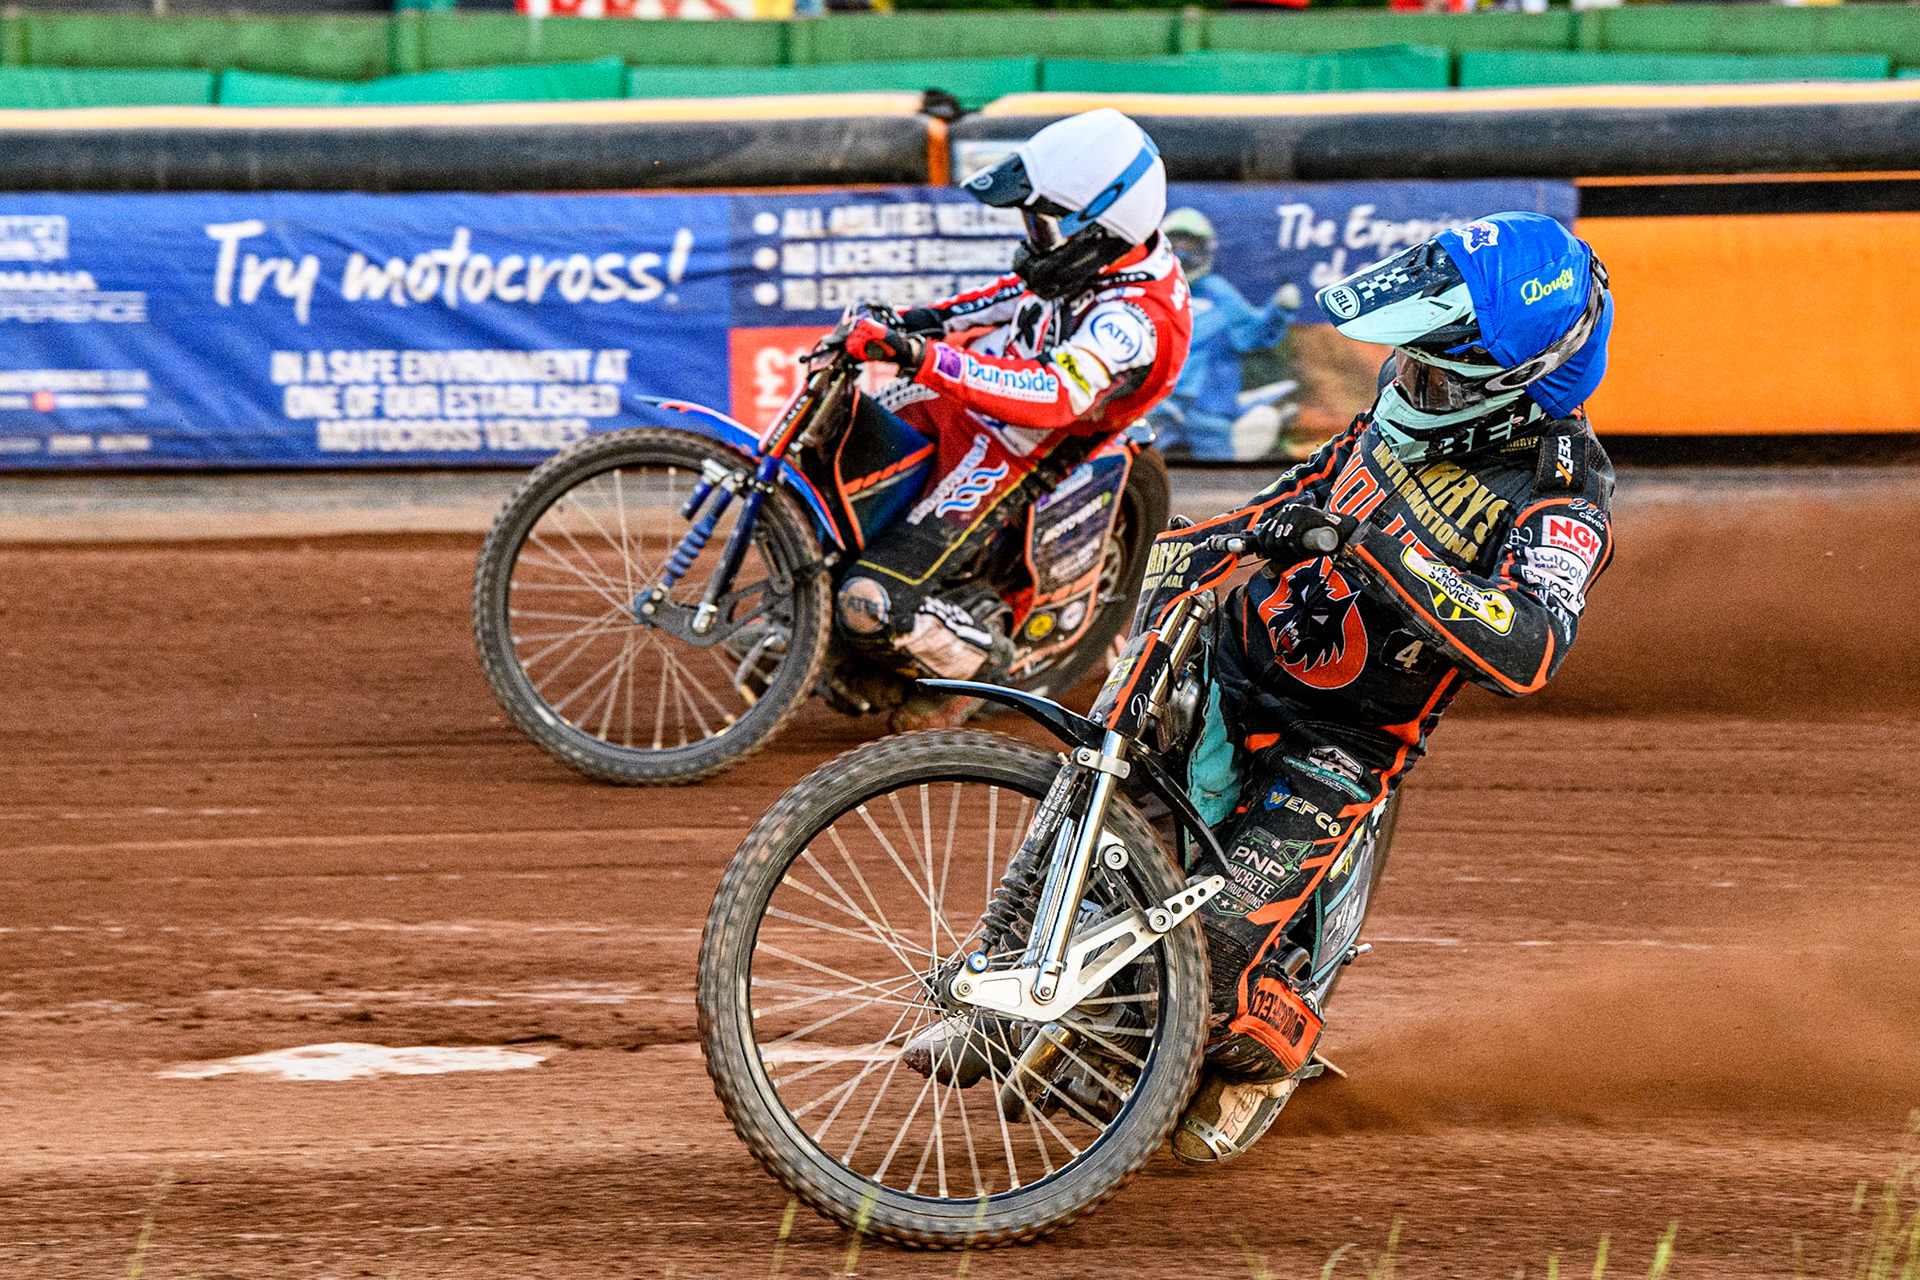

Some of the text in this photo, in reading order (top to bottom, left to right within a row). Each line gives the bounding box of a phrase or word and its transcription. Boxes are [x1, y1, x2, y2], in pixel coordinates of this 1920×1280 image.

[1277, 203, 1336, 249] The
[204, 219, 694, 325] Try motocross!
[1521, 267, 1575, 306] Dougy
[1332, 287, 1352, 313] BELL
[329, 350, 399, 383] SAFE
[401, 350, 591, 383] ENVIRONMENT
[594, 350, 631, 382] AT
[968, 357, 1057, 392] burnside
[445, 385, 620, 417] ESTABLISHED
[1415, 460, 1509, 545] RRYS
[1549, 518, 1600, 561] NGK
[1549, 538, 1580, 556] SPARK
[1425, 570, 1482, 613] SERVICES
[1395, 639, 1424, 668] 4
[1049, 784, 1068, 811] SHOCKS
[1269, 791, 1341, 836] WEFCO
[1231, 845, 1286, 878] PNP
